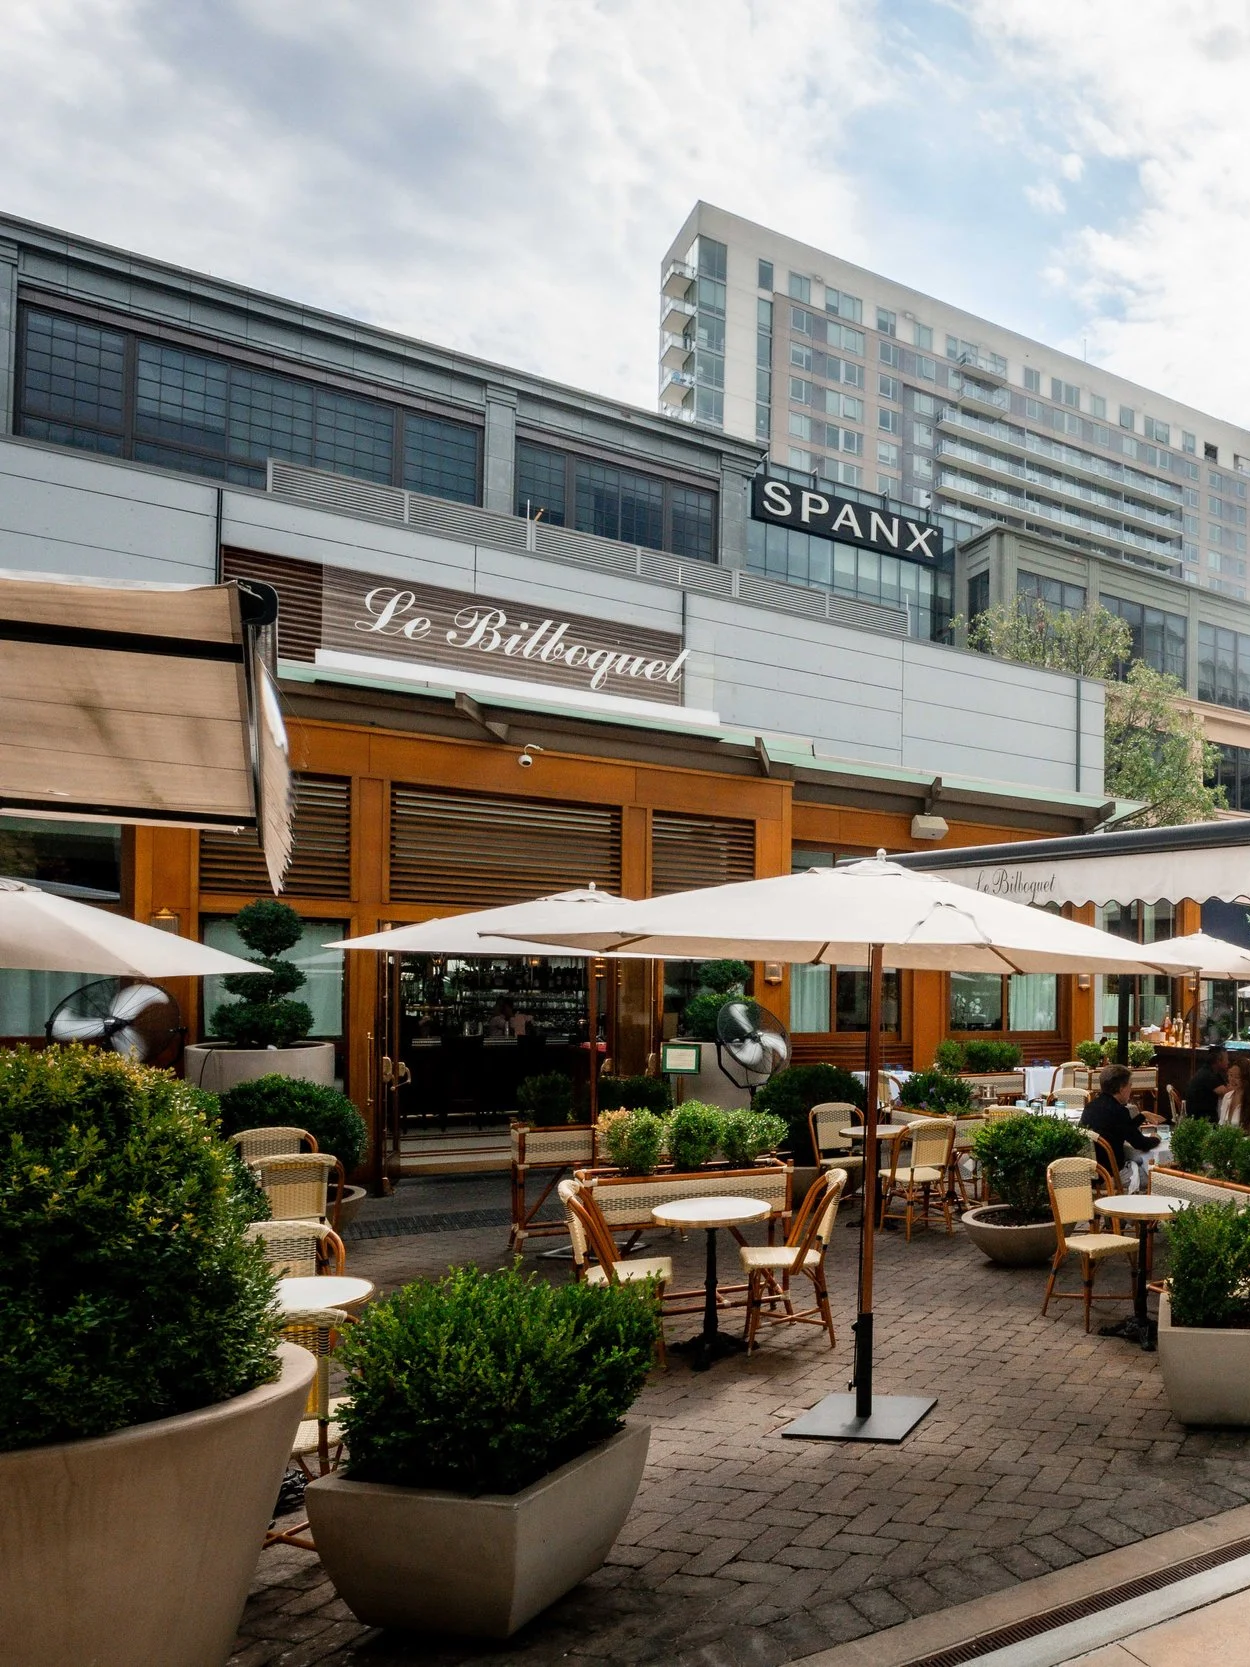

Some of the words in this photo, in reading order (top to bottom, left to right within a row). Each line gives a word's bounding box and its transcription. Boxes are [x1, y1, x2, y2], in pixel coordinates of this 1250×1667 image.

[762, 481, 935, 558] SPANX
[354, 586, 432, 640] Le
[446, 605, 692, 690] Bilboquet
[975, 869, 990, 894] Le
[992, 867, 1057, 902] Bilboquet
